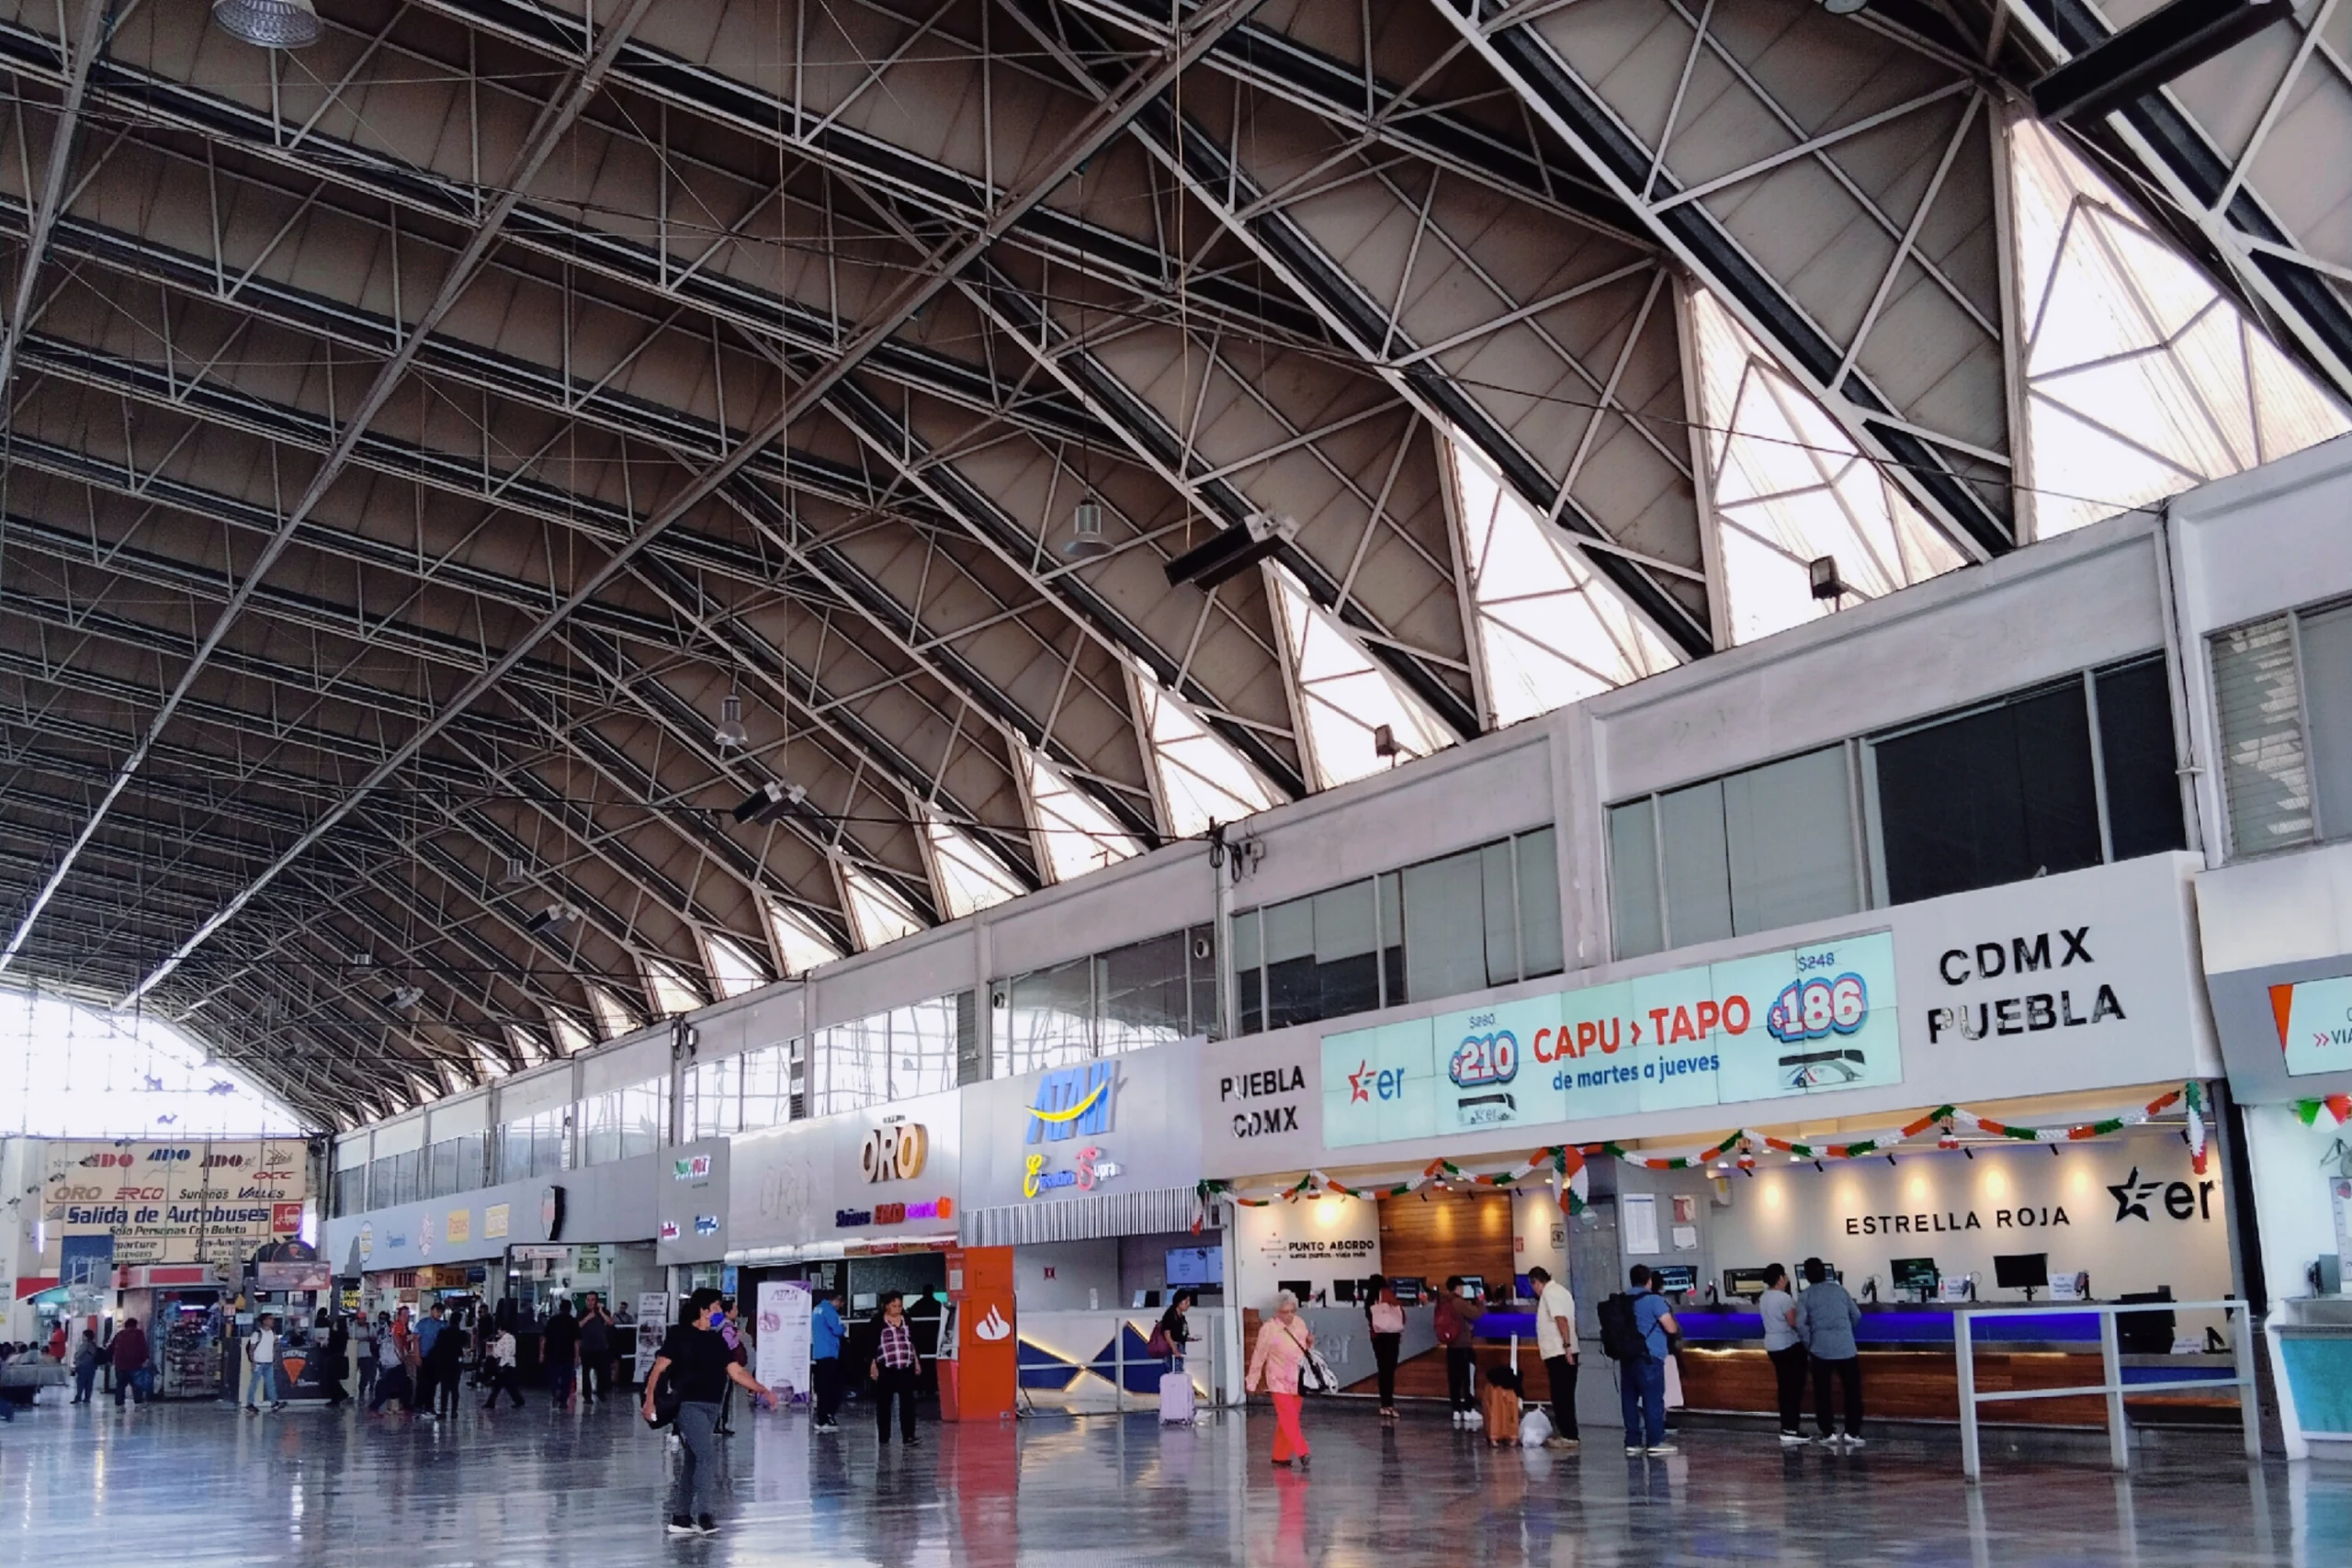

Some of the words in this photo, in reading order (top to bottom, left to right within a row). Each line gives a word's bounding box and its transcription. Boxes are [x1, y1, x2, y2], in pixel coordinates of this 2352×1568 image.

[1798, 953, 1835, 972] $248
[1939, 926, 2095, 986] CDMX
[1772, 978, 1865, 1036] $186
[1928, 984, 2127, 1044] PUEBLA
[1533, 1017, 1620, 1063] CAPU
[1648, 995, 1751, 1045] TAPO
[1452, 1036, 1515, 1081] $210
[1553, 1071, 1573, 1090] de
[1577, 1065, 1639, 1088] martes
[1644, 1063, 1655, 1078] a
[1658, 1055, 1721, 1083] jueves
[1221, 1066, 1306, 1102] PUEBLA
[1377, 1068, 1405, 1100] er
[1233, 1105, 1298, 1138] CDMX
[146, 1148, 191, 1161] ADO
[198, 1155, 243, 1168] ADO
[860, 1122, 928, 1184] ORO
[253, 1171, 296, 1179] OCC
[54, 1186, 103, 1201] ORO
[2165, 1179, 2215, 1222] er
[67, 1205, 128, 1224] Salida
[134, 1205, 159, 1224] de
[167, 1205, 270, 1224] Autobuses
[109, 1225, 132, 1236] Solo
[134, 1225, 187, 1235] Personas
[210, 1224, 246, 1235] Boleto
[1846, 1211, 1982, 1235] ESTRELLA
[1996, 1206, 2071, 1228] ROJA
[113, 1240, 158, 1249] parture
[1289, 1241, 1325, 1251] PUNTO
[1329, 1240, 1374, 1250] ABORDO
